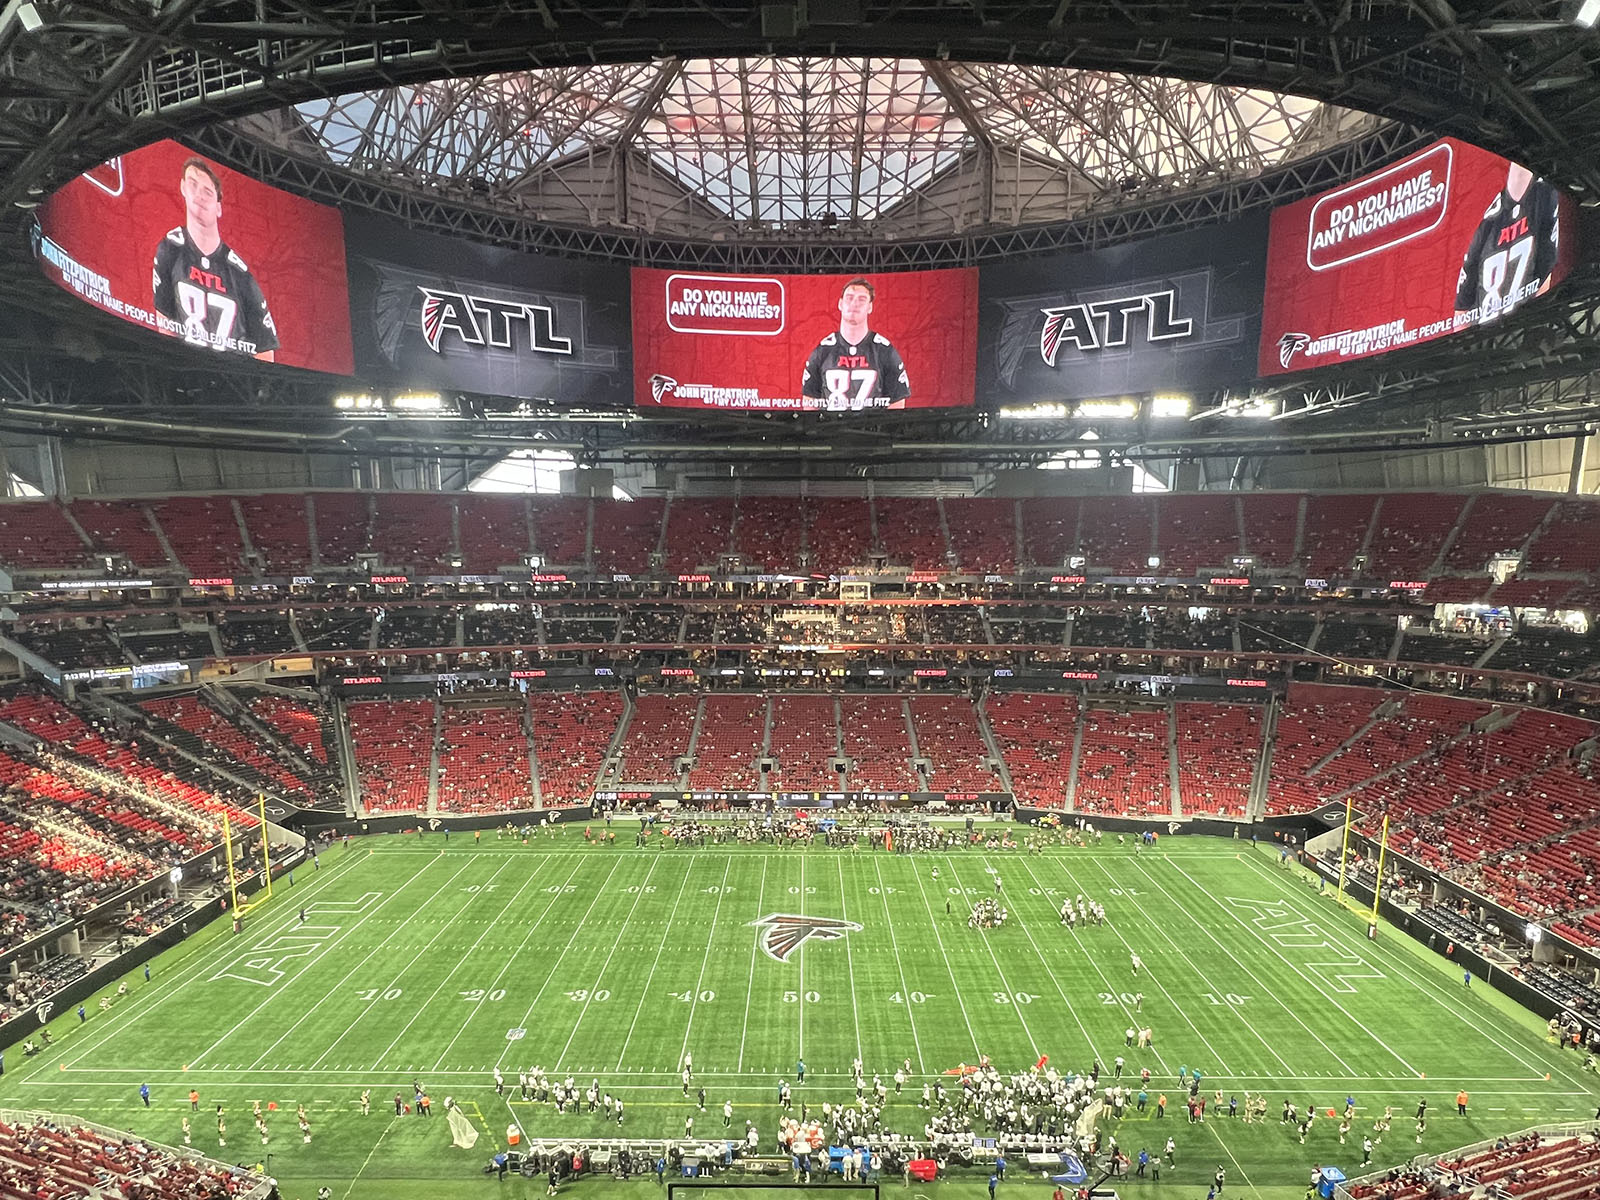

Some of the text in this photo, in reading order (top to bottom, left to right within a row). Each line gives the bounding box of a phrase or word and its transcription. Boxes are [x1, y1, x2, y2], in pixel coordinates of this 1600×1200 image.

[1330, 169, 1433, 228] DO YOU HAVE
[1312, 183, 1445, 250] ANY NICKNAMES?
[1497, 216, 1529, 246] ATL
[190, 266, 227, 293] ATL
[1478, 235, 1534, 324] 87
[683, 288, 768, 306] DO YOU HAVE
[177, 281, 237, 351] 87
[670, 301, 780, 319] ANY NICKNAMES?
[1370, 337, 1393, 351] LAST
[1393, 331, 1417, 347] NAME
[1419, 317, 1453, 338] PEOPLE
[1453, 306, 1485, 328] MOSTLY
[1525, 278, 1541, 297] FITZ
[103, 294, 125, 314] NAME
[124, 303, 156, 326] PEOPLE
[155, 316, 188, 335] MOSTLY
[237, 340, 258, 354] FITZ
[417, 286, 572, 354] ATL
[1040, 289, 1192, 367] ATL
[1304, 318, 1405, 357] JOHN FITZPATRICK
[837, 356, 869, 368] ATL
[673, 386, 699, 398] JOHN
[700, 387, 759, 401] FITZPATRICK
[825, 369, 877, 411] 87
[730, 399, 748, 407] LAST
[750, 399, 771, 407] NAME
[772, 399, 801, 408] PEOPLE
[802, 398, 829, 407] MOSTLY
[874, 397, 891, 407] FITZ
[189, 578, 233, 586] FALCONS
[371, 576, 408, 584] ATLANTA
[678, 575, 711, 583] ATLANTA
[1050, 576, 1086, 584] ATLANTA
[1210, 578, 1249, 586] FALCONS
[1390, 581, 1428, 589] ATLANT
[510, 670, 546, 678] FALCONS
[1062, 672, 1098, 680] ATLANTA
[343, 677, 382, 685] ATLANTA
[1227, 679, 1267, 687] FALCONS
[206, 892, 383, 986] ATL
[1224, 896, 1388, 993] ATL
[358, 988, 403, 1001] 10
[463, 989, 506, 1001] 20
[569, 990, 611, 1001] 30
[676, 990, 715, 1002] 40
[783, 991, 821, 1003] 50
[888, 991, 926, 1003] 40
[993, 992, 1032, 1004] 30
[1097, 992, 1140, 1005] 20
[1200, 993, 1244, 1006] 10
